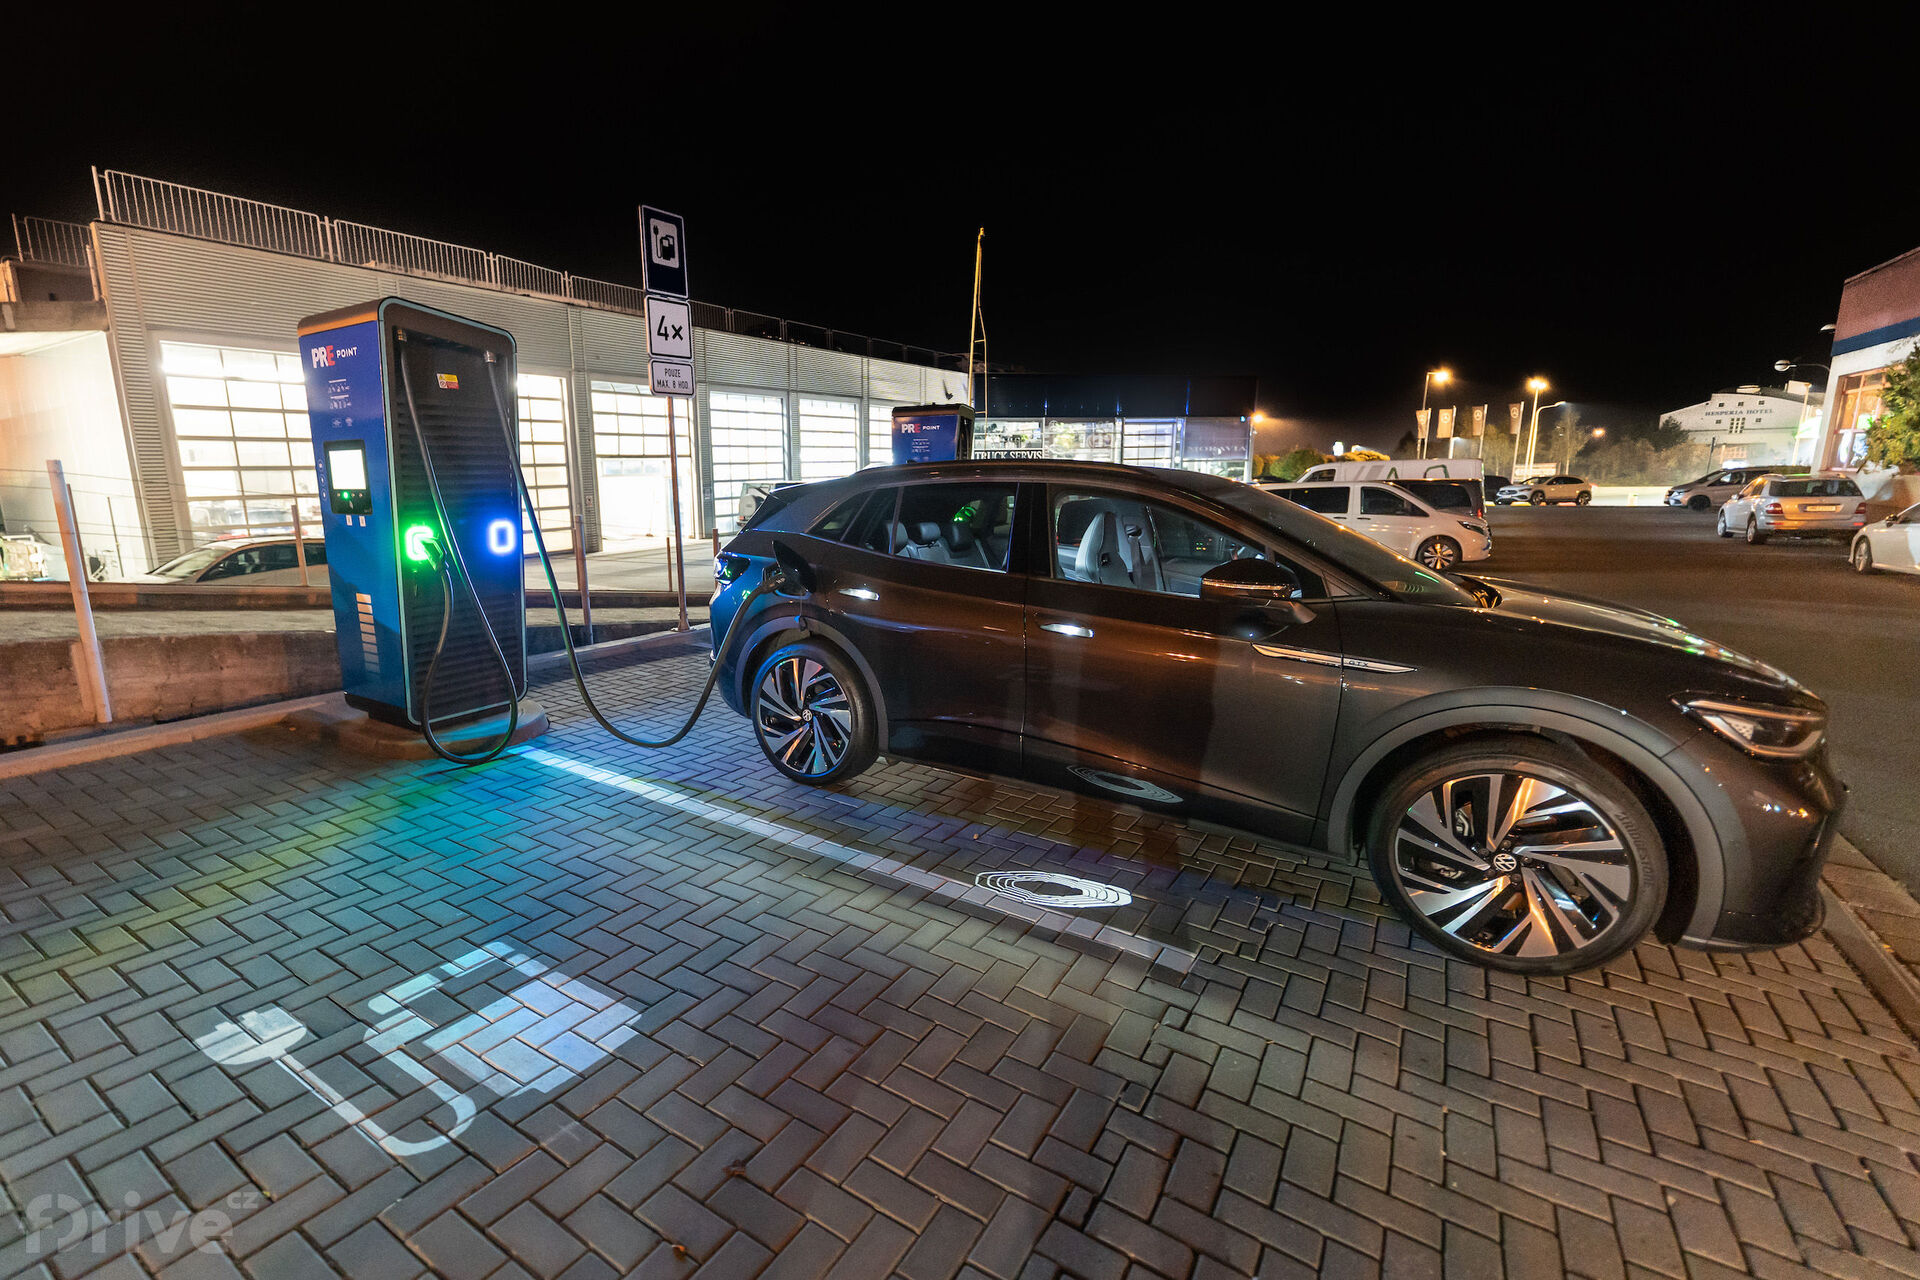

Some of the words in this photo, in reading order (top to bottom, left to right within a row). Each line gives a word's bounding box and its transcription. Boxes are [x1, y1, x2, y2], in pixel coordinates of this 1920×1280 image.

[311, 345, 336, 369] PRE
[336, 346, 358, 359] POINT
[664, 367, 681, 378] POUZE
[656, 379, 670, 389] MAX.
[901, 423, 921, 434] PRE
[922, 424, 941, 432] POINT
[974, 450, 1008, 460] TRUCK
[1010, 450, 1043, 460] SERVIS
